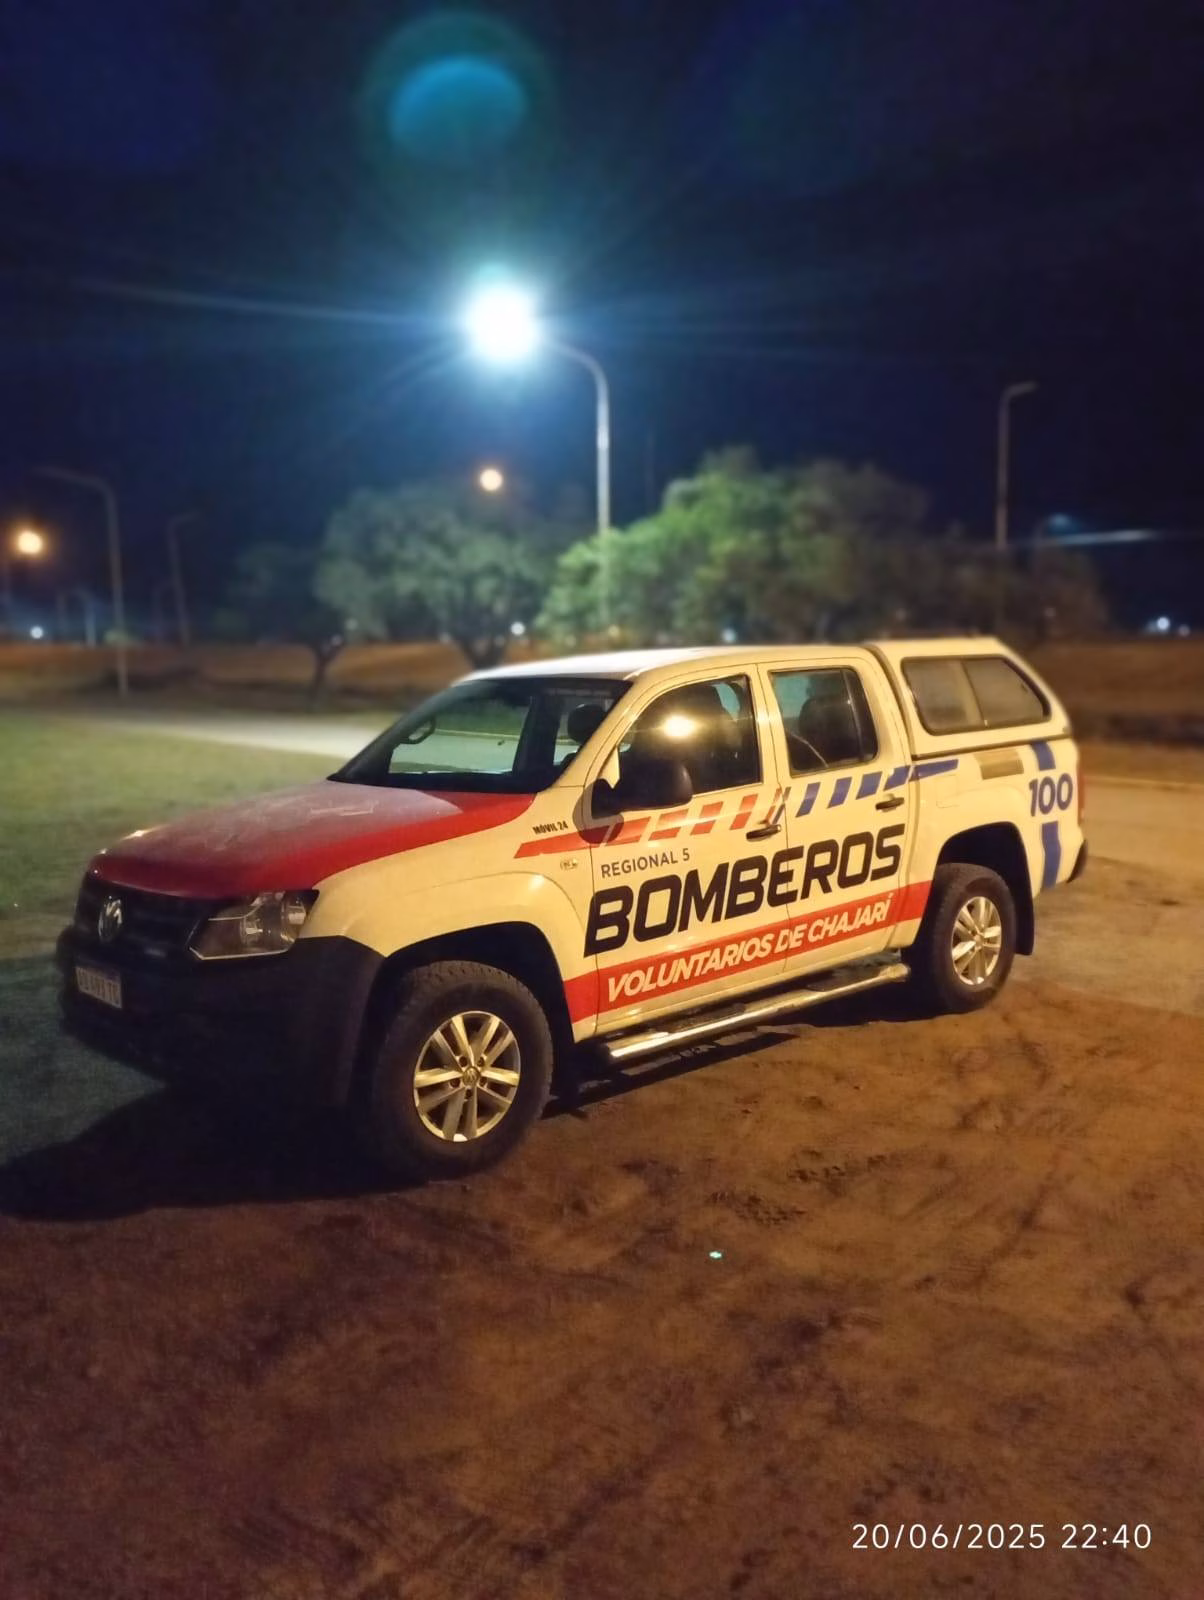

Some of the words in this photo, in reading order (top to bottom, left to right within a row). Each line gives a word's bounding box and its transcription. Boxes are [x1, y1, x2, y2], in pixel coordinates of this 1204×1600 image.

[1029, 773, 1073, 817] 100
[557, 820, 569, 831] 24
[601, 852, 678, 878] REGIONAL
[682, 848, 690, 862] 5
[584, 823, 905, 958] BOMBEROS
[608, 933, 775, 1002] VOLUNTARIOS
[774, 923, 808, 954] DE
[807, 892, 894, 942] CHAJARÍ
